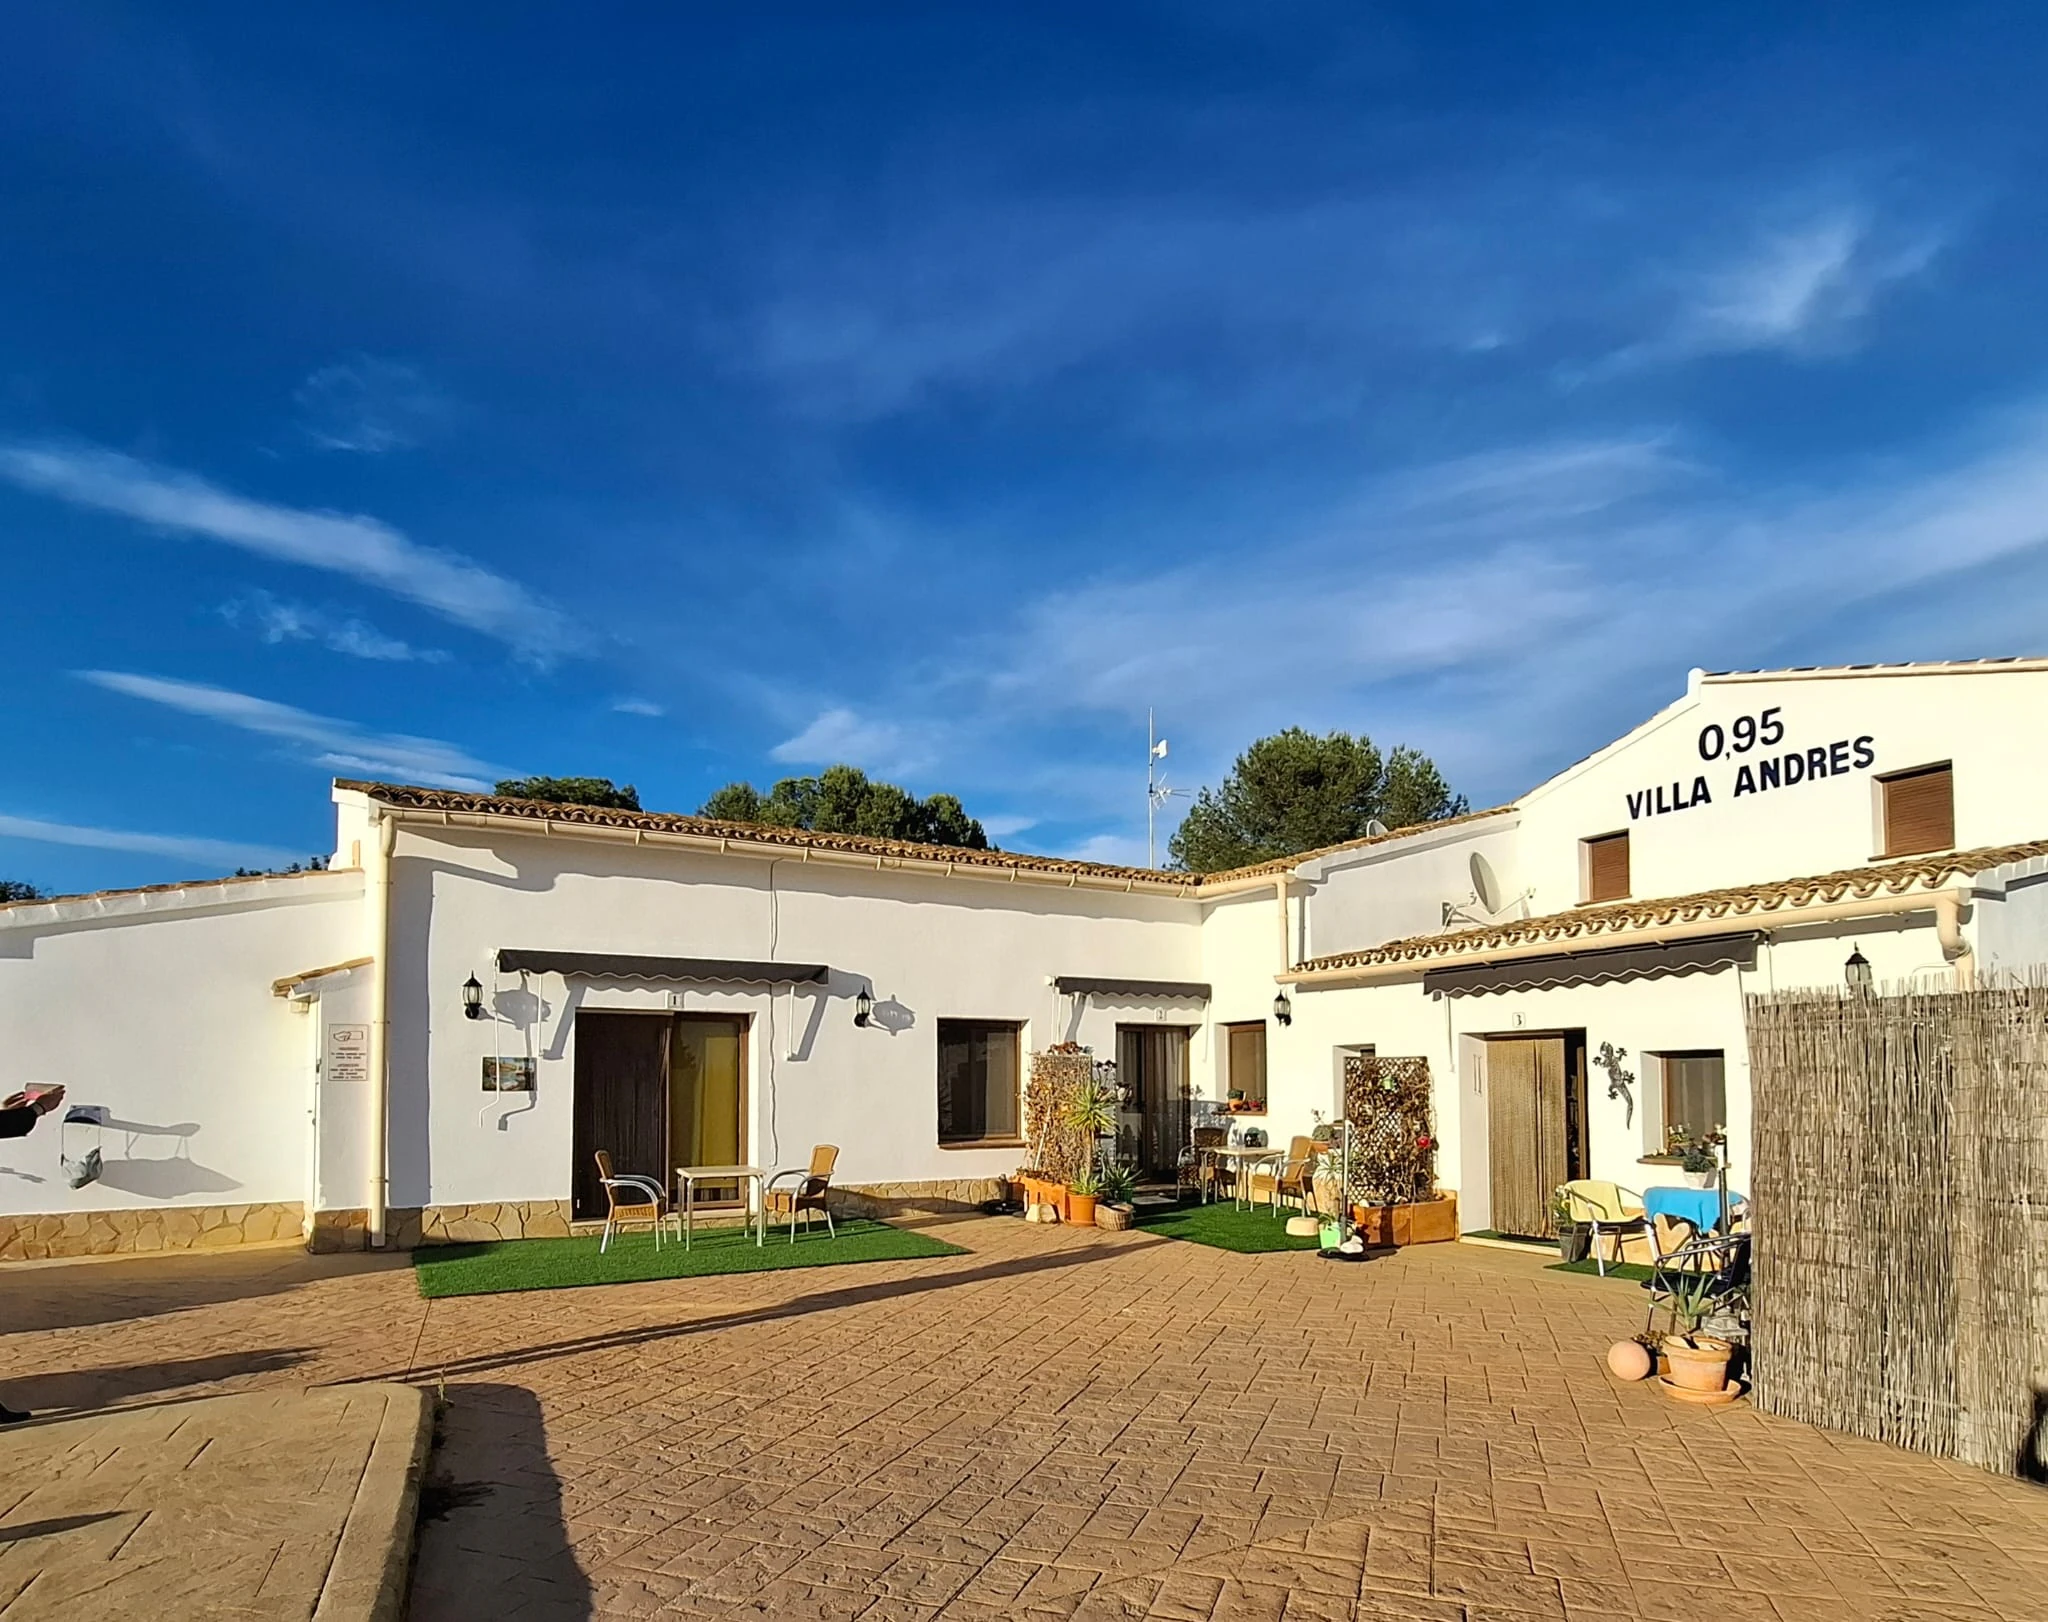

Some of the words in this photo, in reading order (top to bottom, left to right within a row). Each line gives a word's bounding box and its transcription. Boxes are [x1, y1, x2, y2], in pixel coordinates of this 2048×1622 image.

[1698, 706, 1785, 762] 0,95
[1626, 775, 1712, 820] VILLA
[1733, 735, 1875, 798] ANDRES
